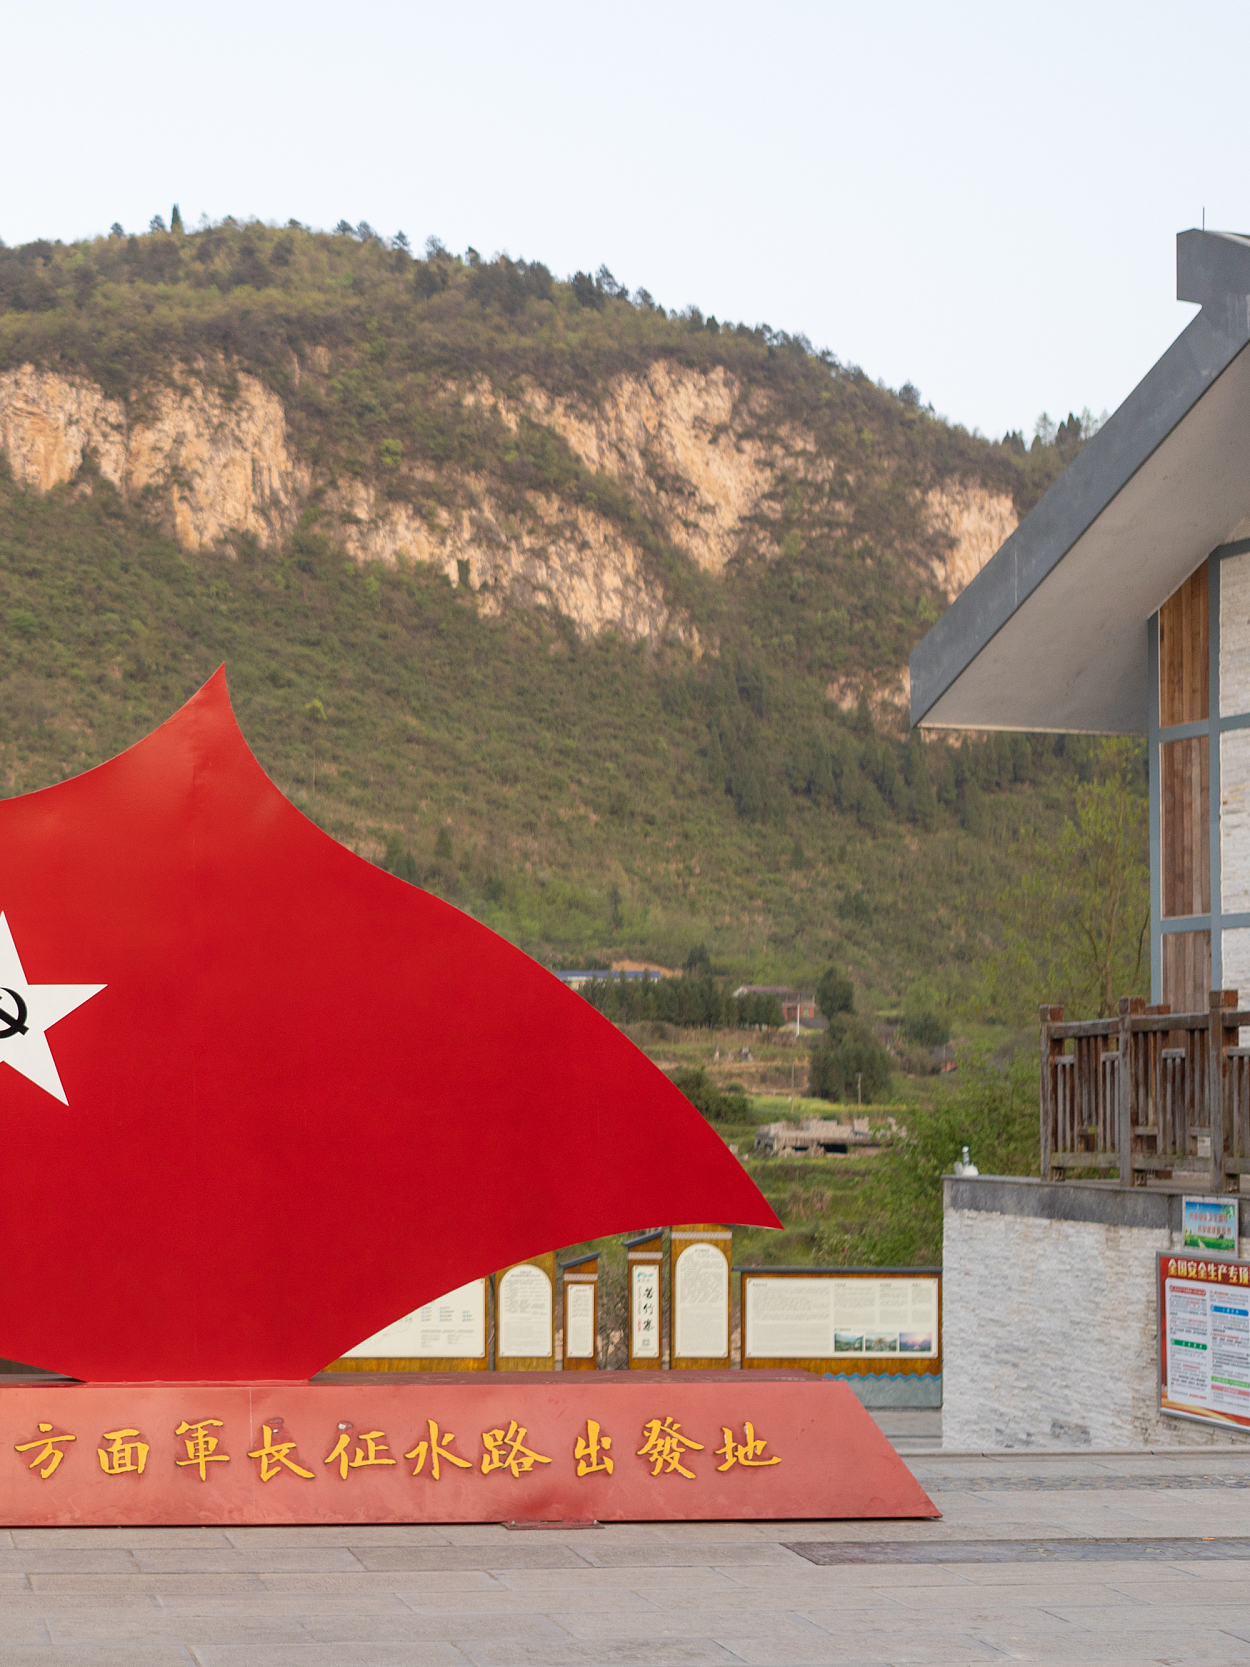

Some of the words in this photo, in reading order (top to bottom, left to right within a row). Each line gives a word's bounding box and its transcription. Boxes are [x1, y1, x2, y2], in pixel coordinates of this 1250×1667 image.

[1167, 1258, 1250, 1285] 全国安全生产专项
